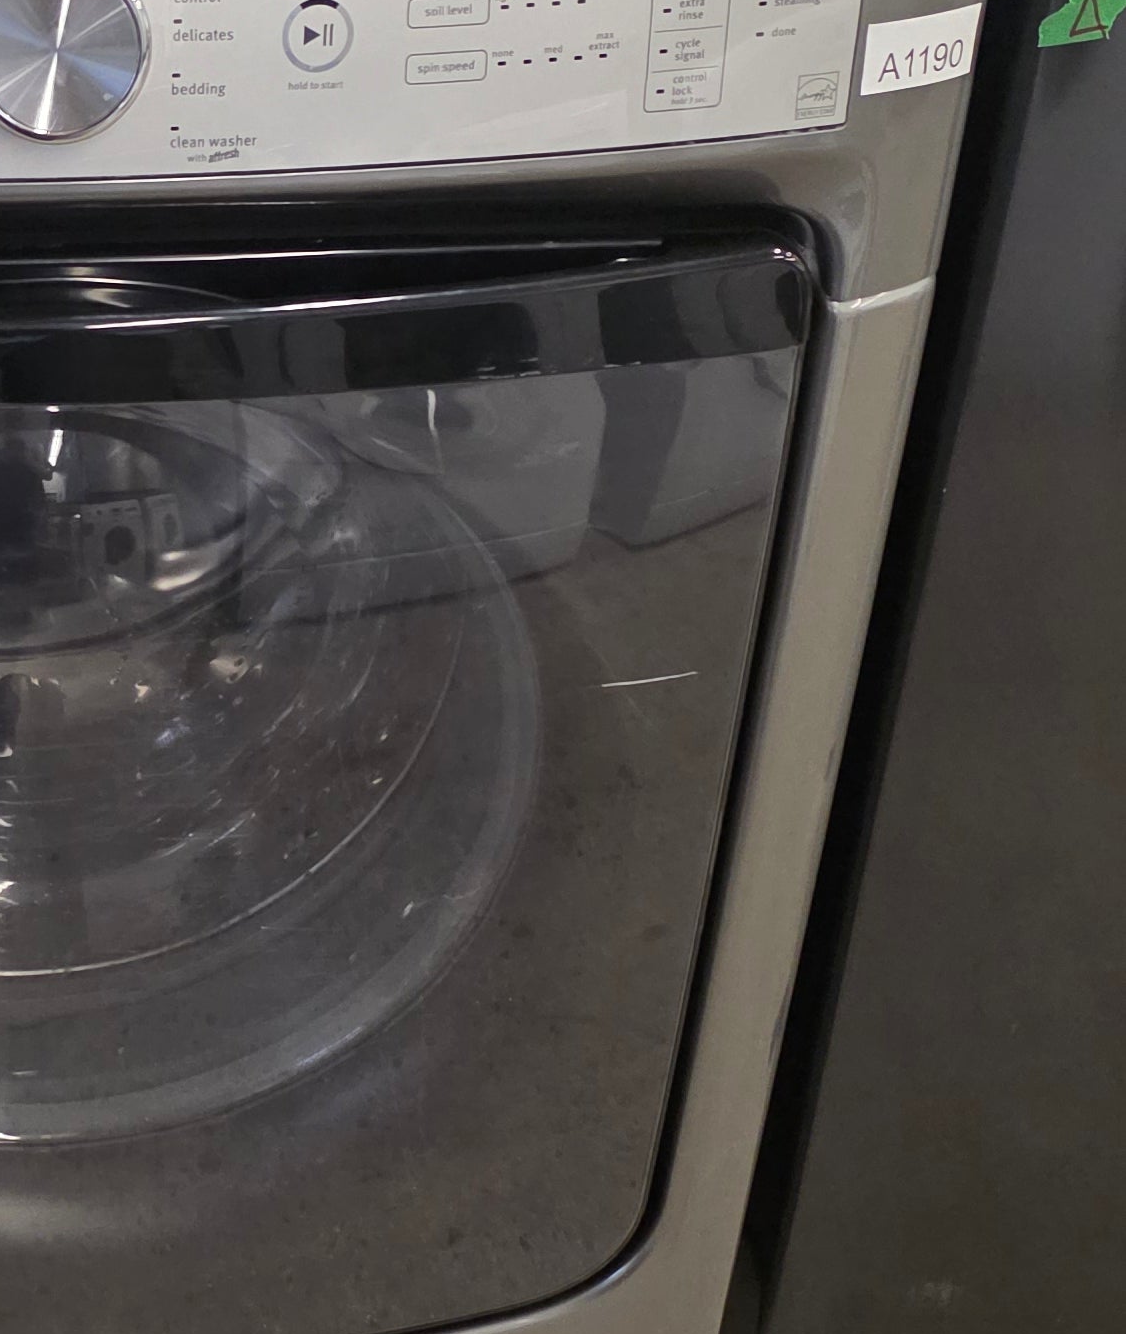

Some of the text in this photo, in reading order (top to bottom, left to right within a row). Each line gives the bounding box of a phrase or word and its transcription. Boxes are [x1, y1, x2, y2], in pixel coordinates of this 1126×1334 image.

[425, 4, 473, 17] soil level
[678, 11, 704, 21] rinse
[172, 29, 235, 42] delicates
[596, 32, 615, 40] max
[771, 27, 797, 38] done
[588, 41, 620, 51] extract
[675, 38, 701, 49] cycle
[492, 49, 514, 58] none
[544, 45, 564, 54] med
[675, 49, 705, 62] signal
[878, 38, 964, 83] A1190
[417, 61, 475, 75] spin speed
[673, 72, 707, 84] control
[171, 83, 226, 97] bedding
[288, 82, 308, 90] hold
[321, 81, 344, 89] start
[672, 85, 692, 96] lock
[170, 135, 258, 149] clean washer
[187, 154, 207, 163] with
